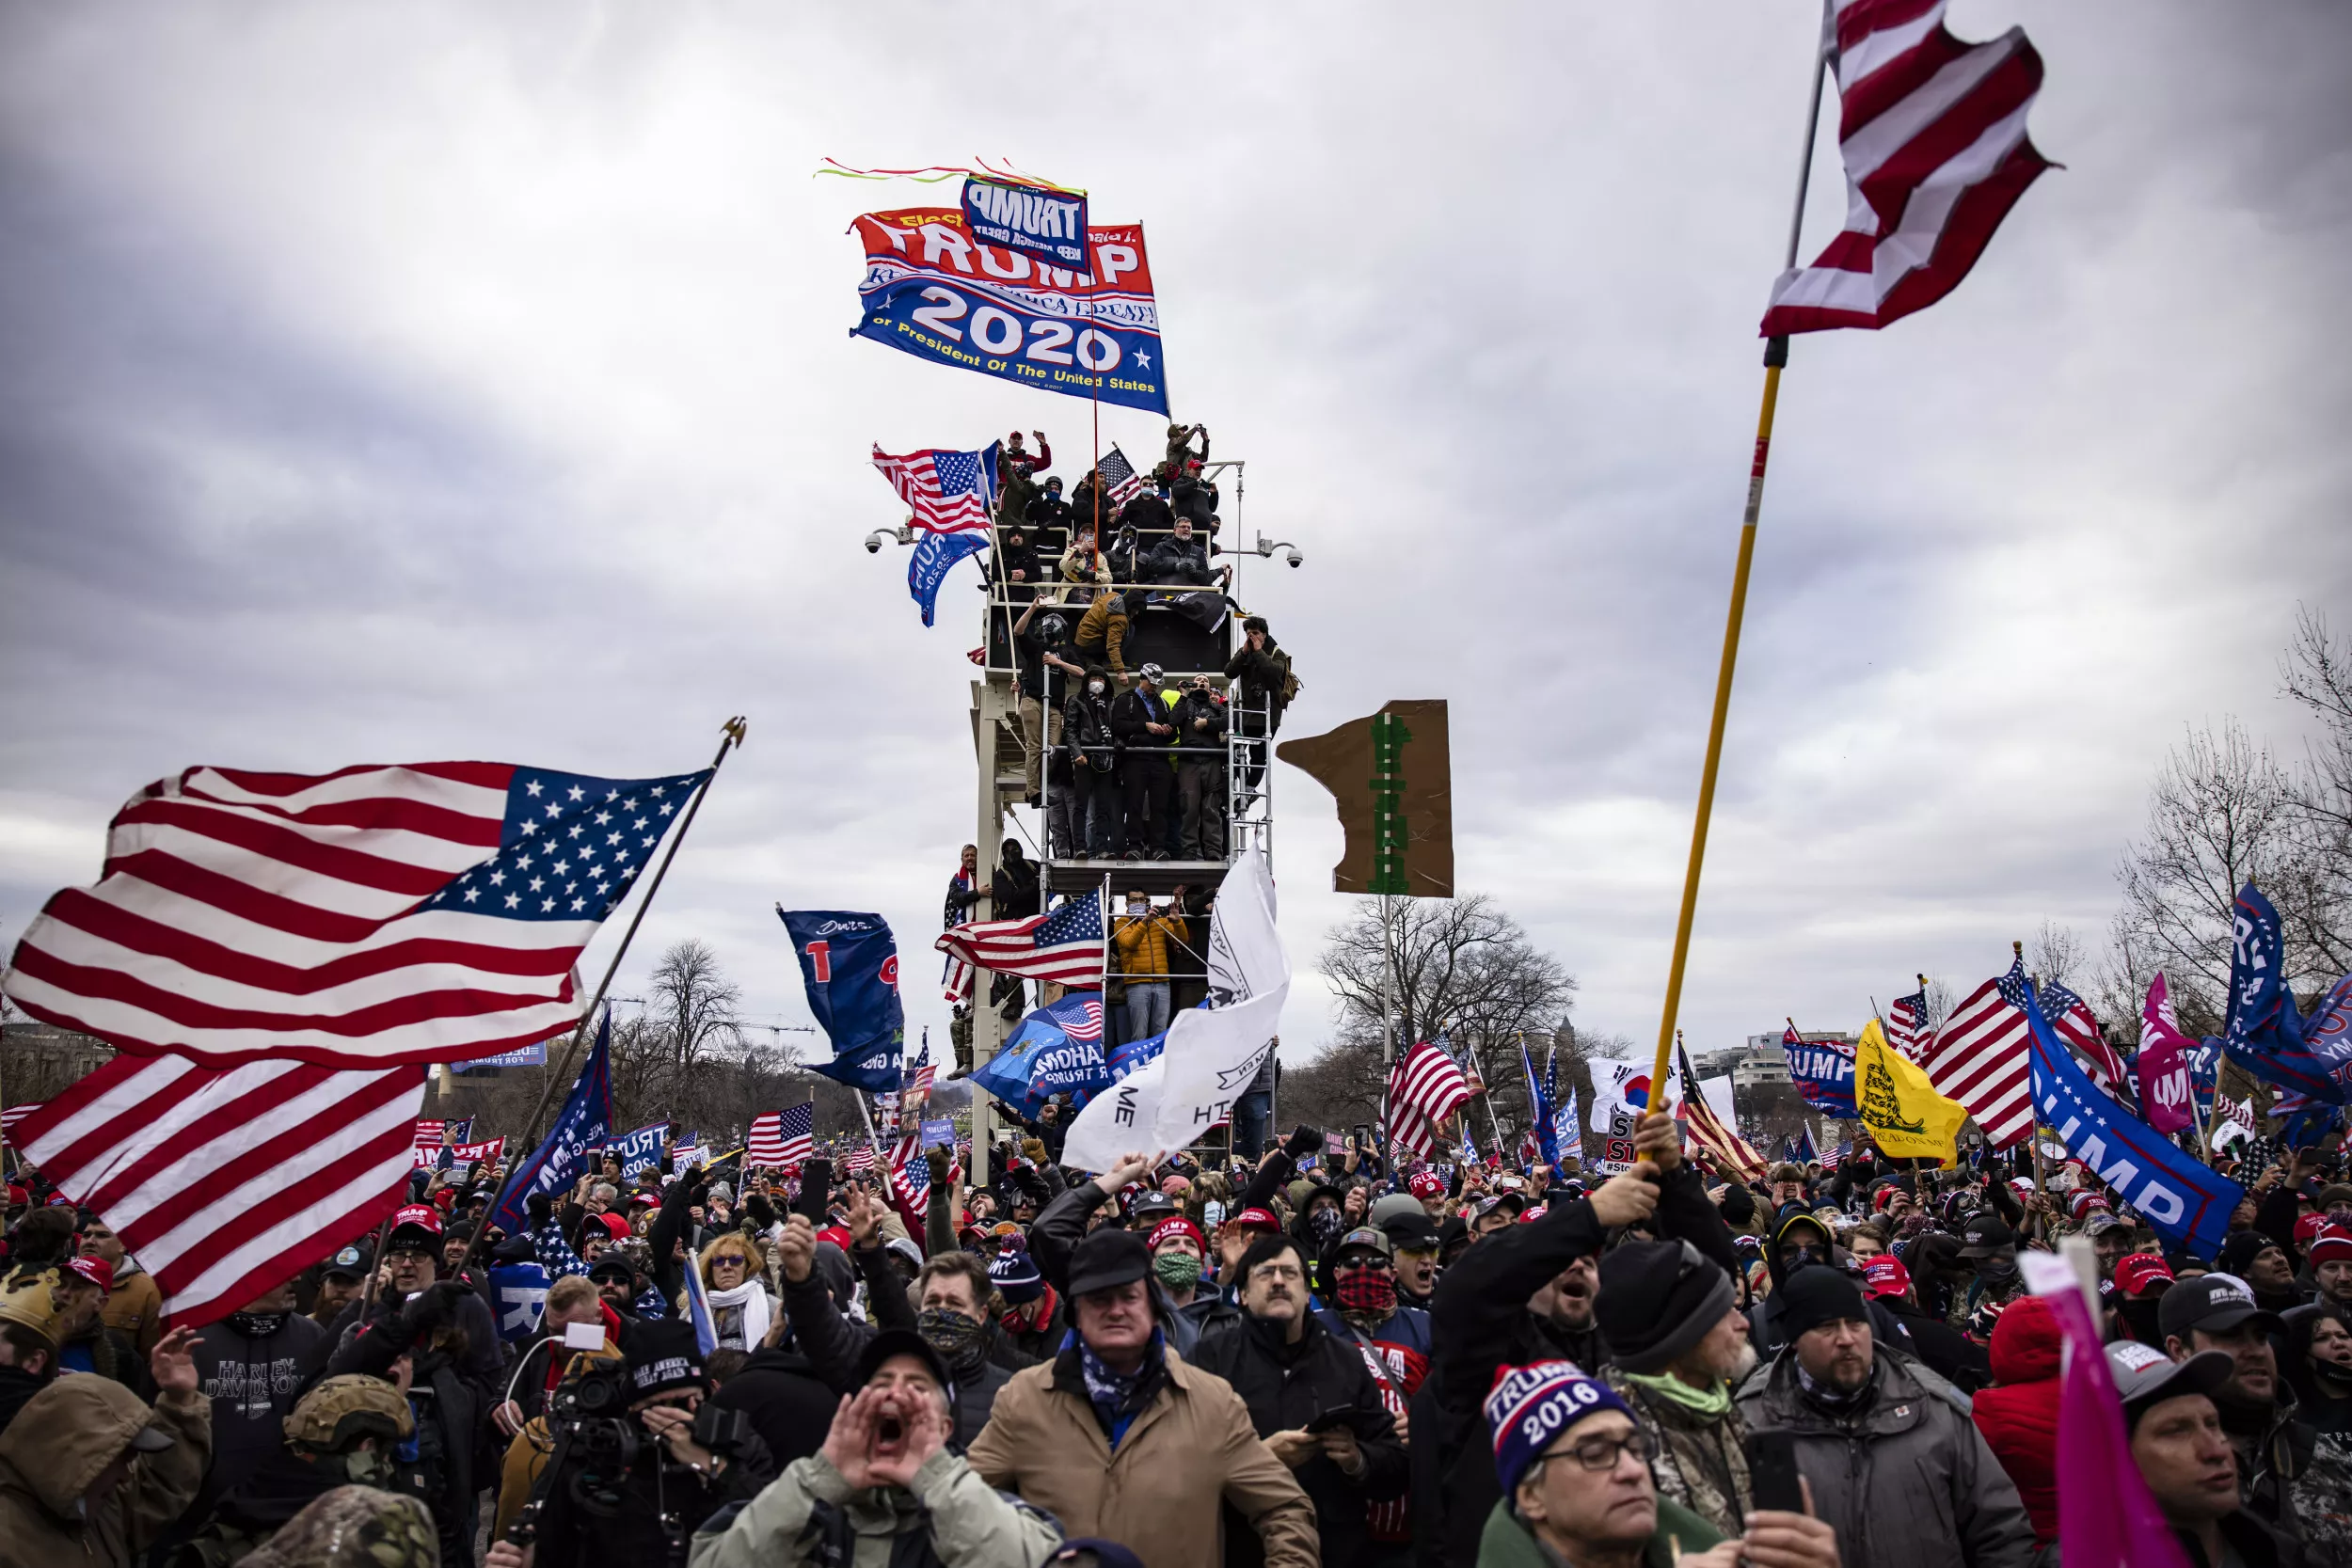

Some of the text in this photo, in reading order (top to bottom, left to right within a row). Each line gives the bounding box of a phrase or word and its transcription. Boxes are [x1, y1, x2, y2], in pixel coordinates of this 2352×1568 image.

[1089, 231, 1121, 243] nald
[912, 286, 1122, 373] 2020
[873, 316, 892, 326] or
[898, 322, 981, 366] President
[987, 359, 1008, 372] Of
[1016, 364, 1047, 378] The
[1055, 371, 1103, 388] United
[1109, 377, 1156, 393] States
[1784, 1049, 1855, 1082] RUMP
[1115, 1086, 1138, 1128] ME
[1326, 1132, 1343, 1146] SAVE
[1872, 1131, 1945, 1148] READ ON ME
[1409, 1171, 1438, 1190] TRUM
[397, 1209, 427, 1220] TRUMP
[1148, 1222, 1188, 1244] TRUMP
[2099, 1279, 2115, 1295] TRUM
[218, 1358, 296, 1380] HARLEY-
[654, 1356, 691, 1371] AMERICA
[661, 1367, 687, 1382] AGAIN
[1360, 1346, 1407, 1385] SA
[205, 1375, 305, 1398] DAVIDSON
[1522, 1382, 1599, 1446] 2016
